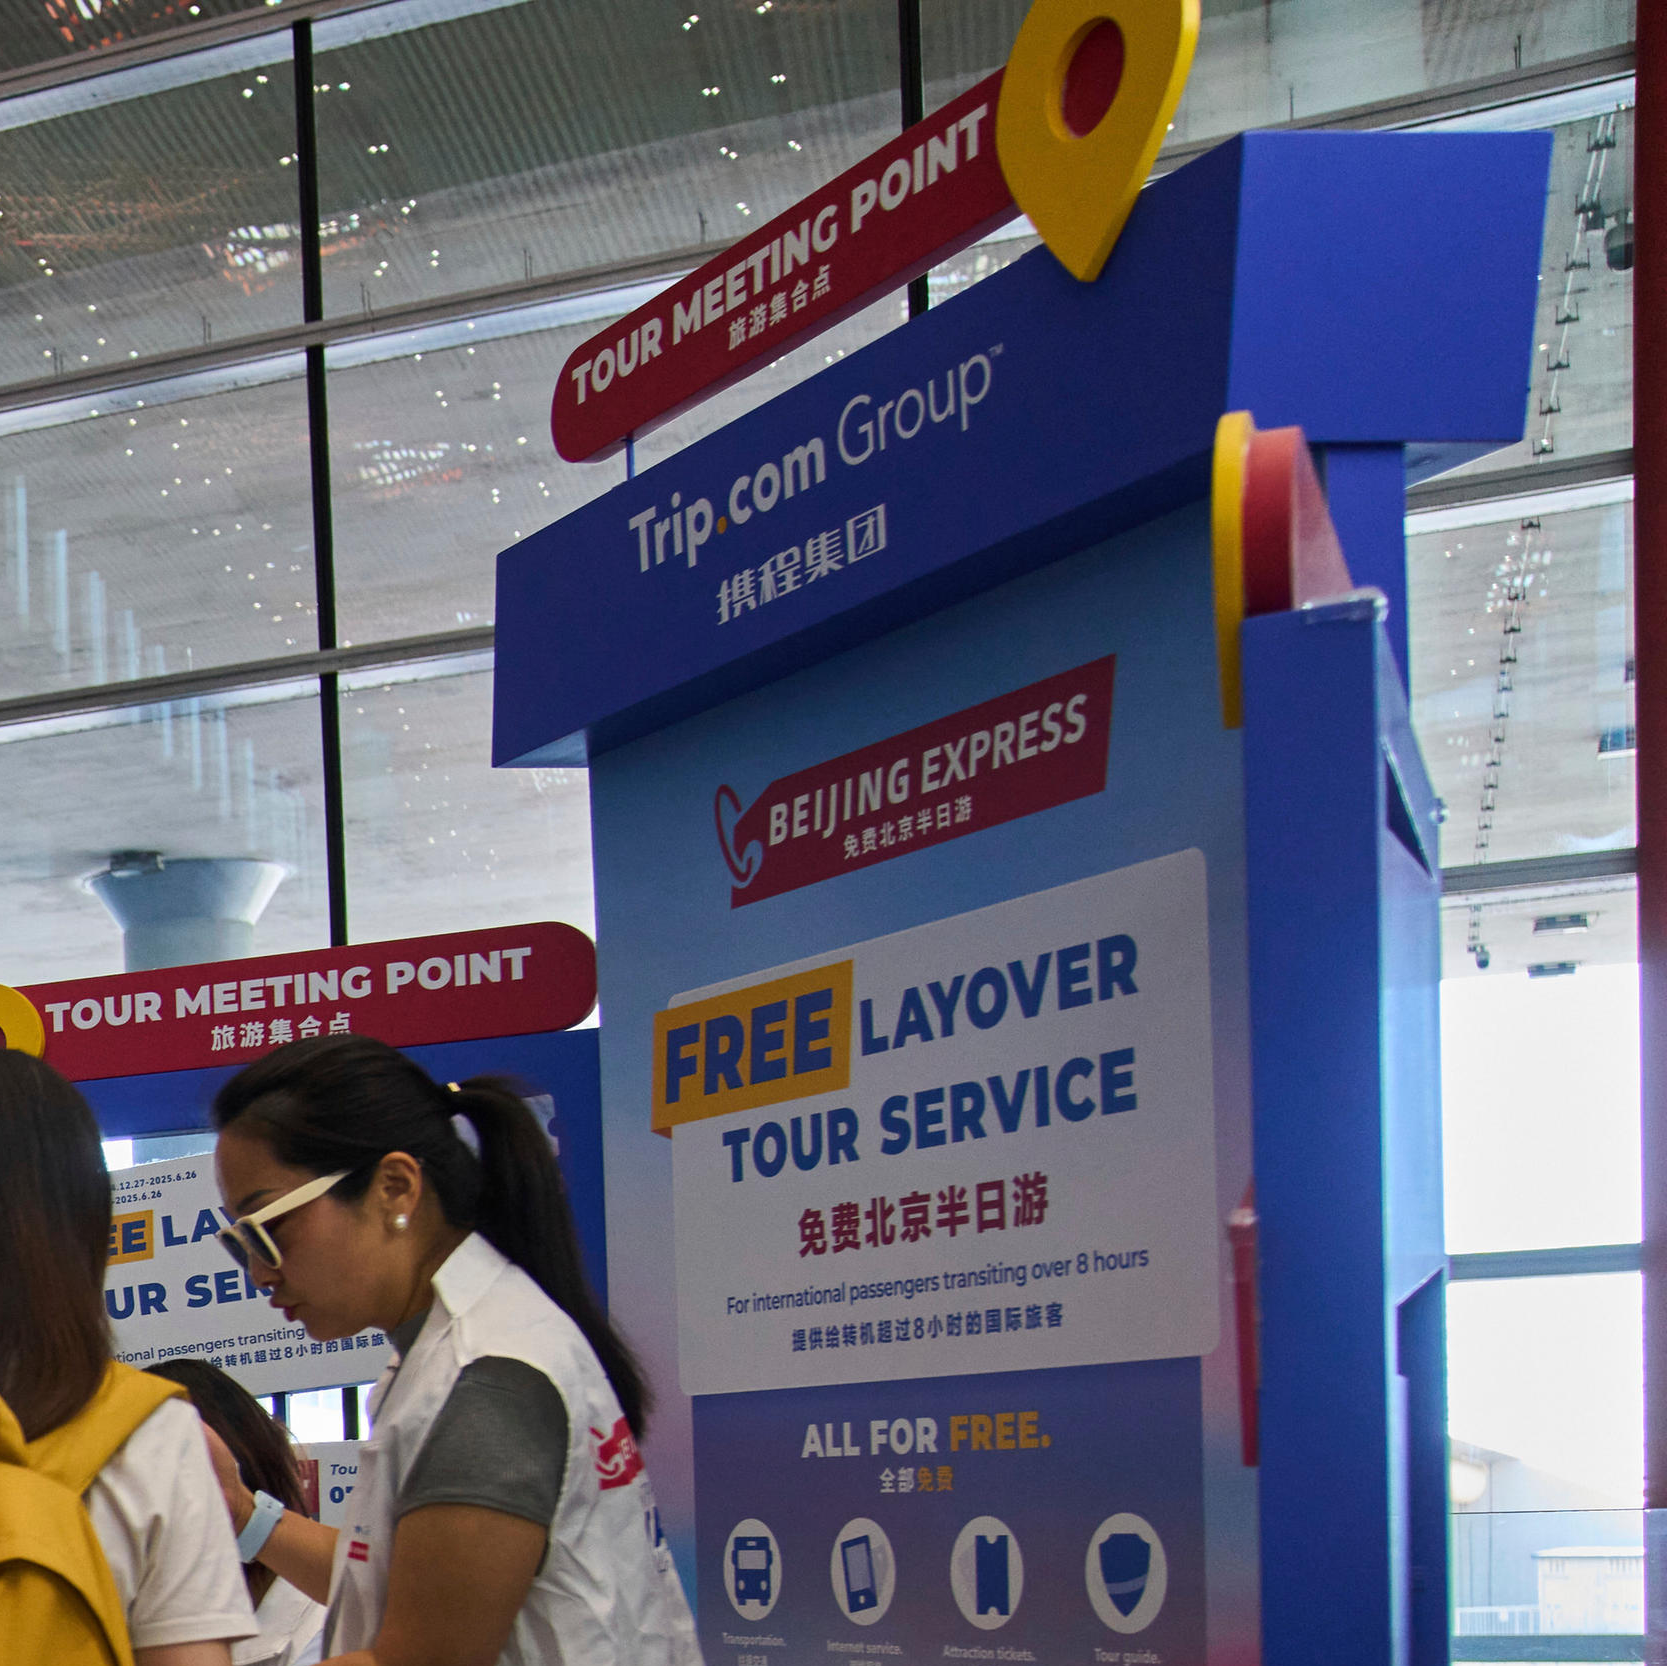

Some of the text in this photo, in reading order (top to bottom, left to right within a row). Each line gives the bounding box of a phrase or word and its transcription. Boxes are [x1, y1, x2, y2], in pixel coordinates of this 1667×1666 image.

[572, 102, 988, 405] TOUR MEETING POINT
[727, 264, 832, 352] 旅游集合点
[628, 436, 827, 573] Trip.com
[715, 503, 888, 626] 携程集团
[769, 693, 1088, 847] BEIJING EXPRESS
[842, 795, 973, 861] 免费北京半日游
[45, 946, 533, 1034] TOUR MEETING POINT
[665, 932, 1140, 1106] FREE LAYOVER
[721, 1046, 1138, 1184] TOUR SERVICE
[797, 1170, 1049, 1260] 免费北京半日游
[726, 1247, 1150, 1315] For international passengers transiting over 8 hours
[157, 1336, 235, 1362] passengers
[237, 1325, 306, 1348] transiting
[791, 1301, 1065, 1353] 提供给转机超过8小时的国际旅客
[800, 1410, 1052, 1459] ALL FOR FREE.
[878, 1465, 955, 1494] 全部免费
[1093, 1647, 1120, 1664] Tour
